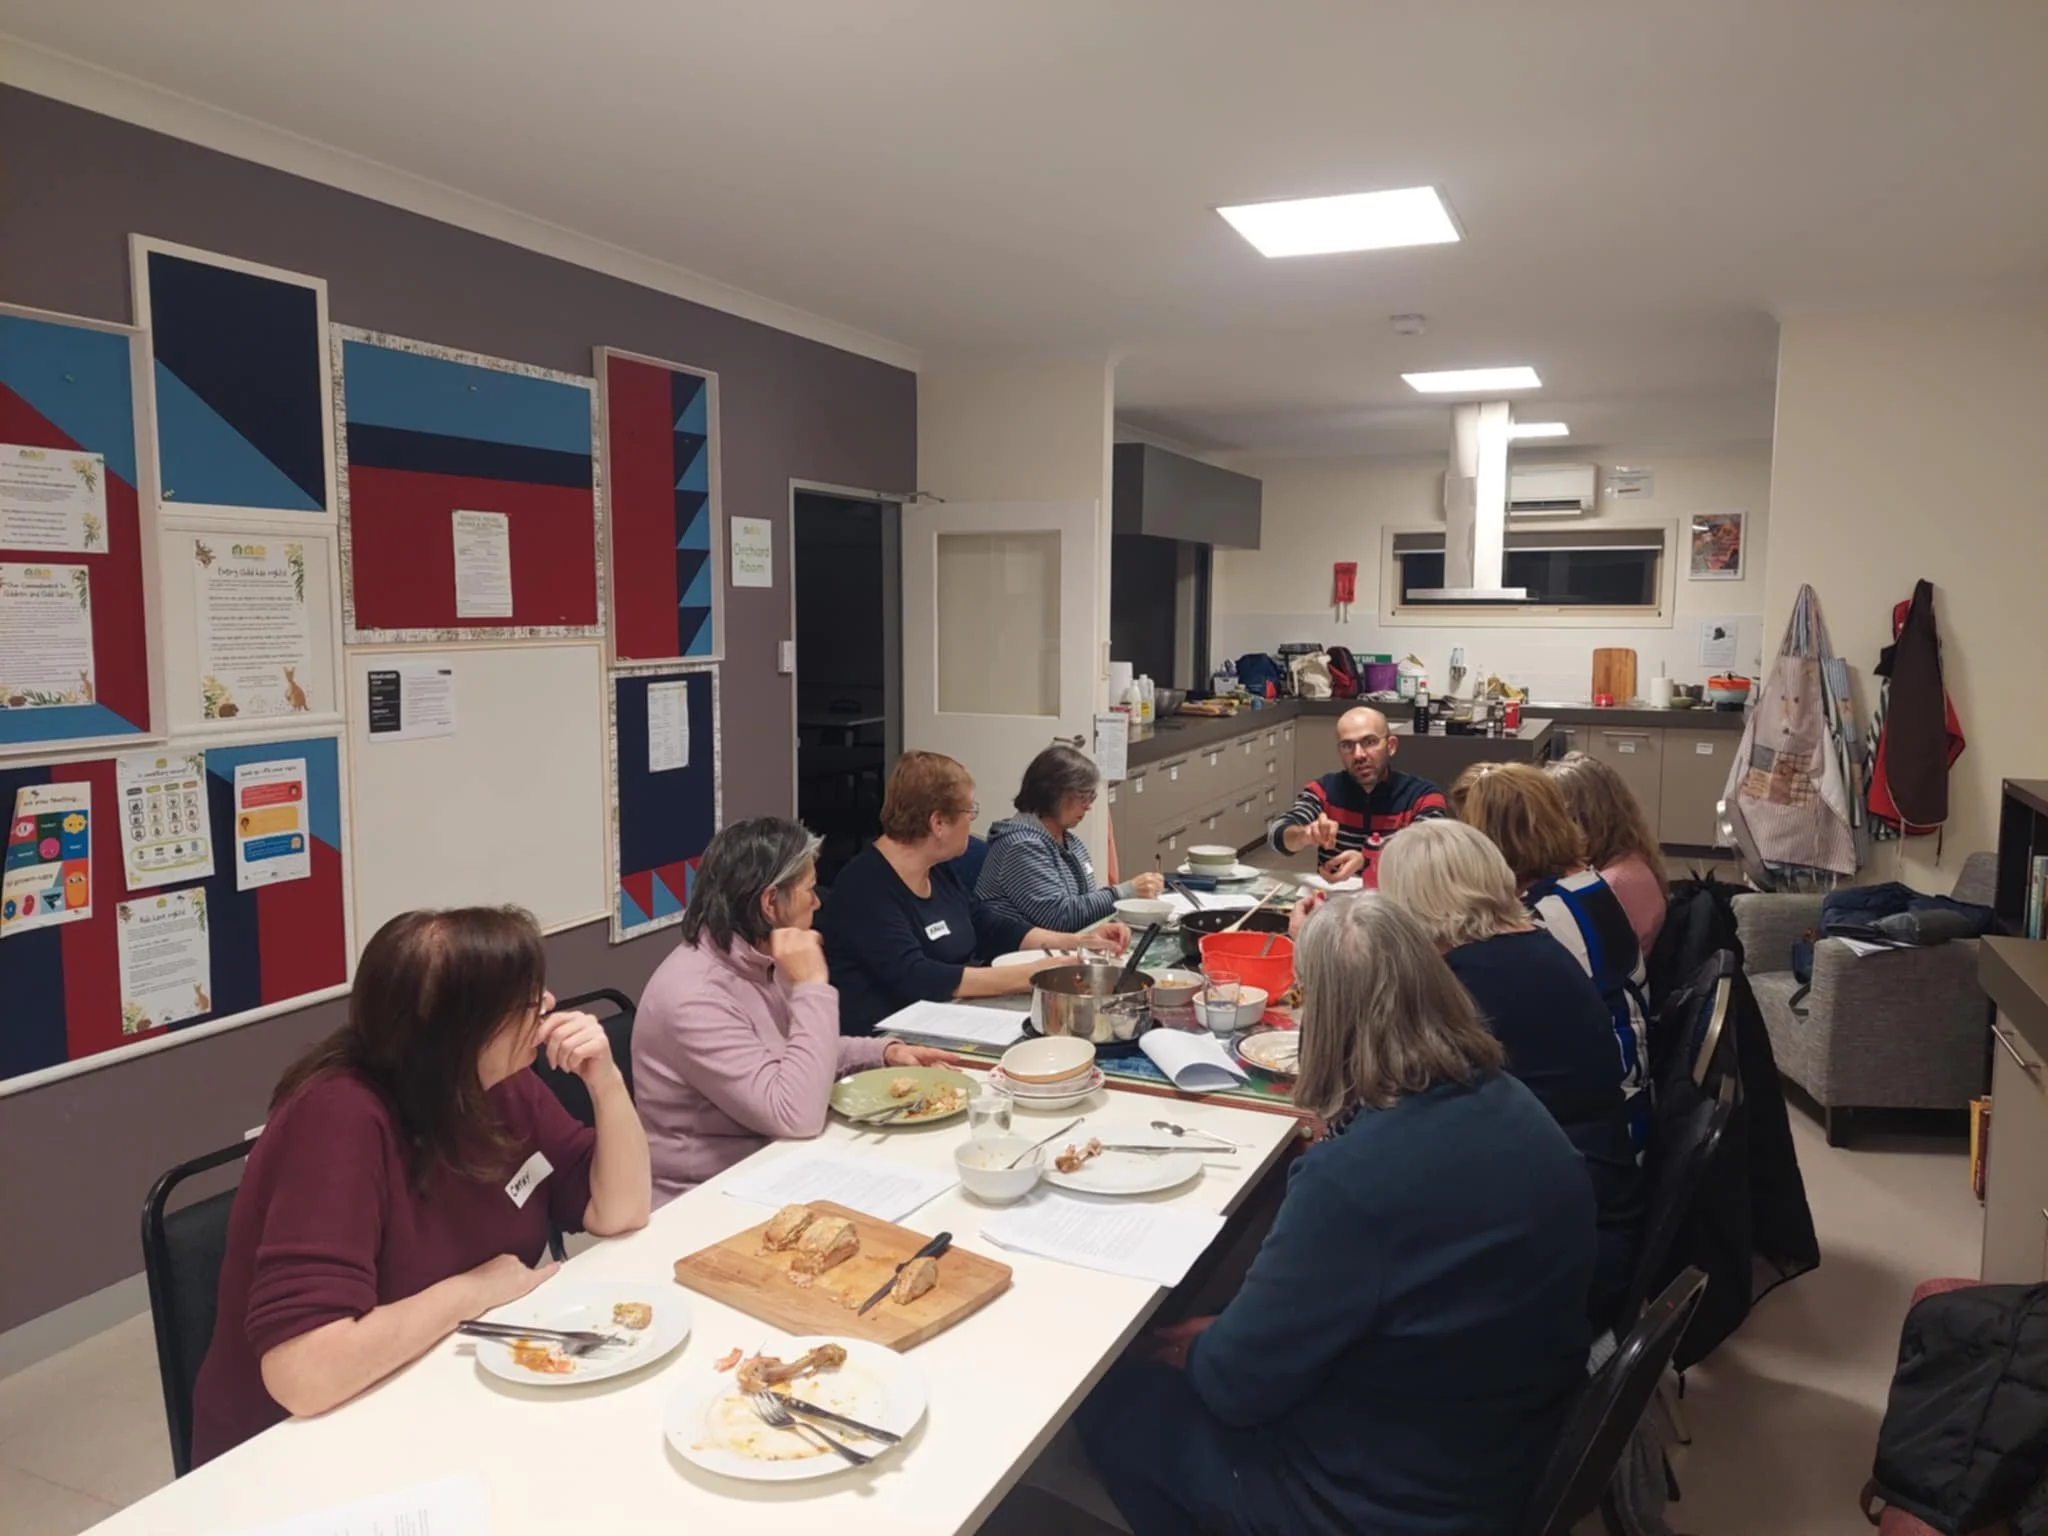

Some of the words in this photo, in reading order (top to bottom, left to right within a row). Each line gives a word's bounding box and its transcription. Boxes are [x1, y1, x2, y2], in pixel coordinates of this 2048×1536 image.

[734, 543, 770, 558] Orchard
[218, 567, 238, 578] Every
[739, 560, 765, 573] Room
[21, 581, 58, 589] Commitment
